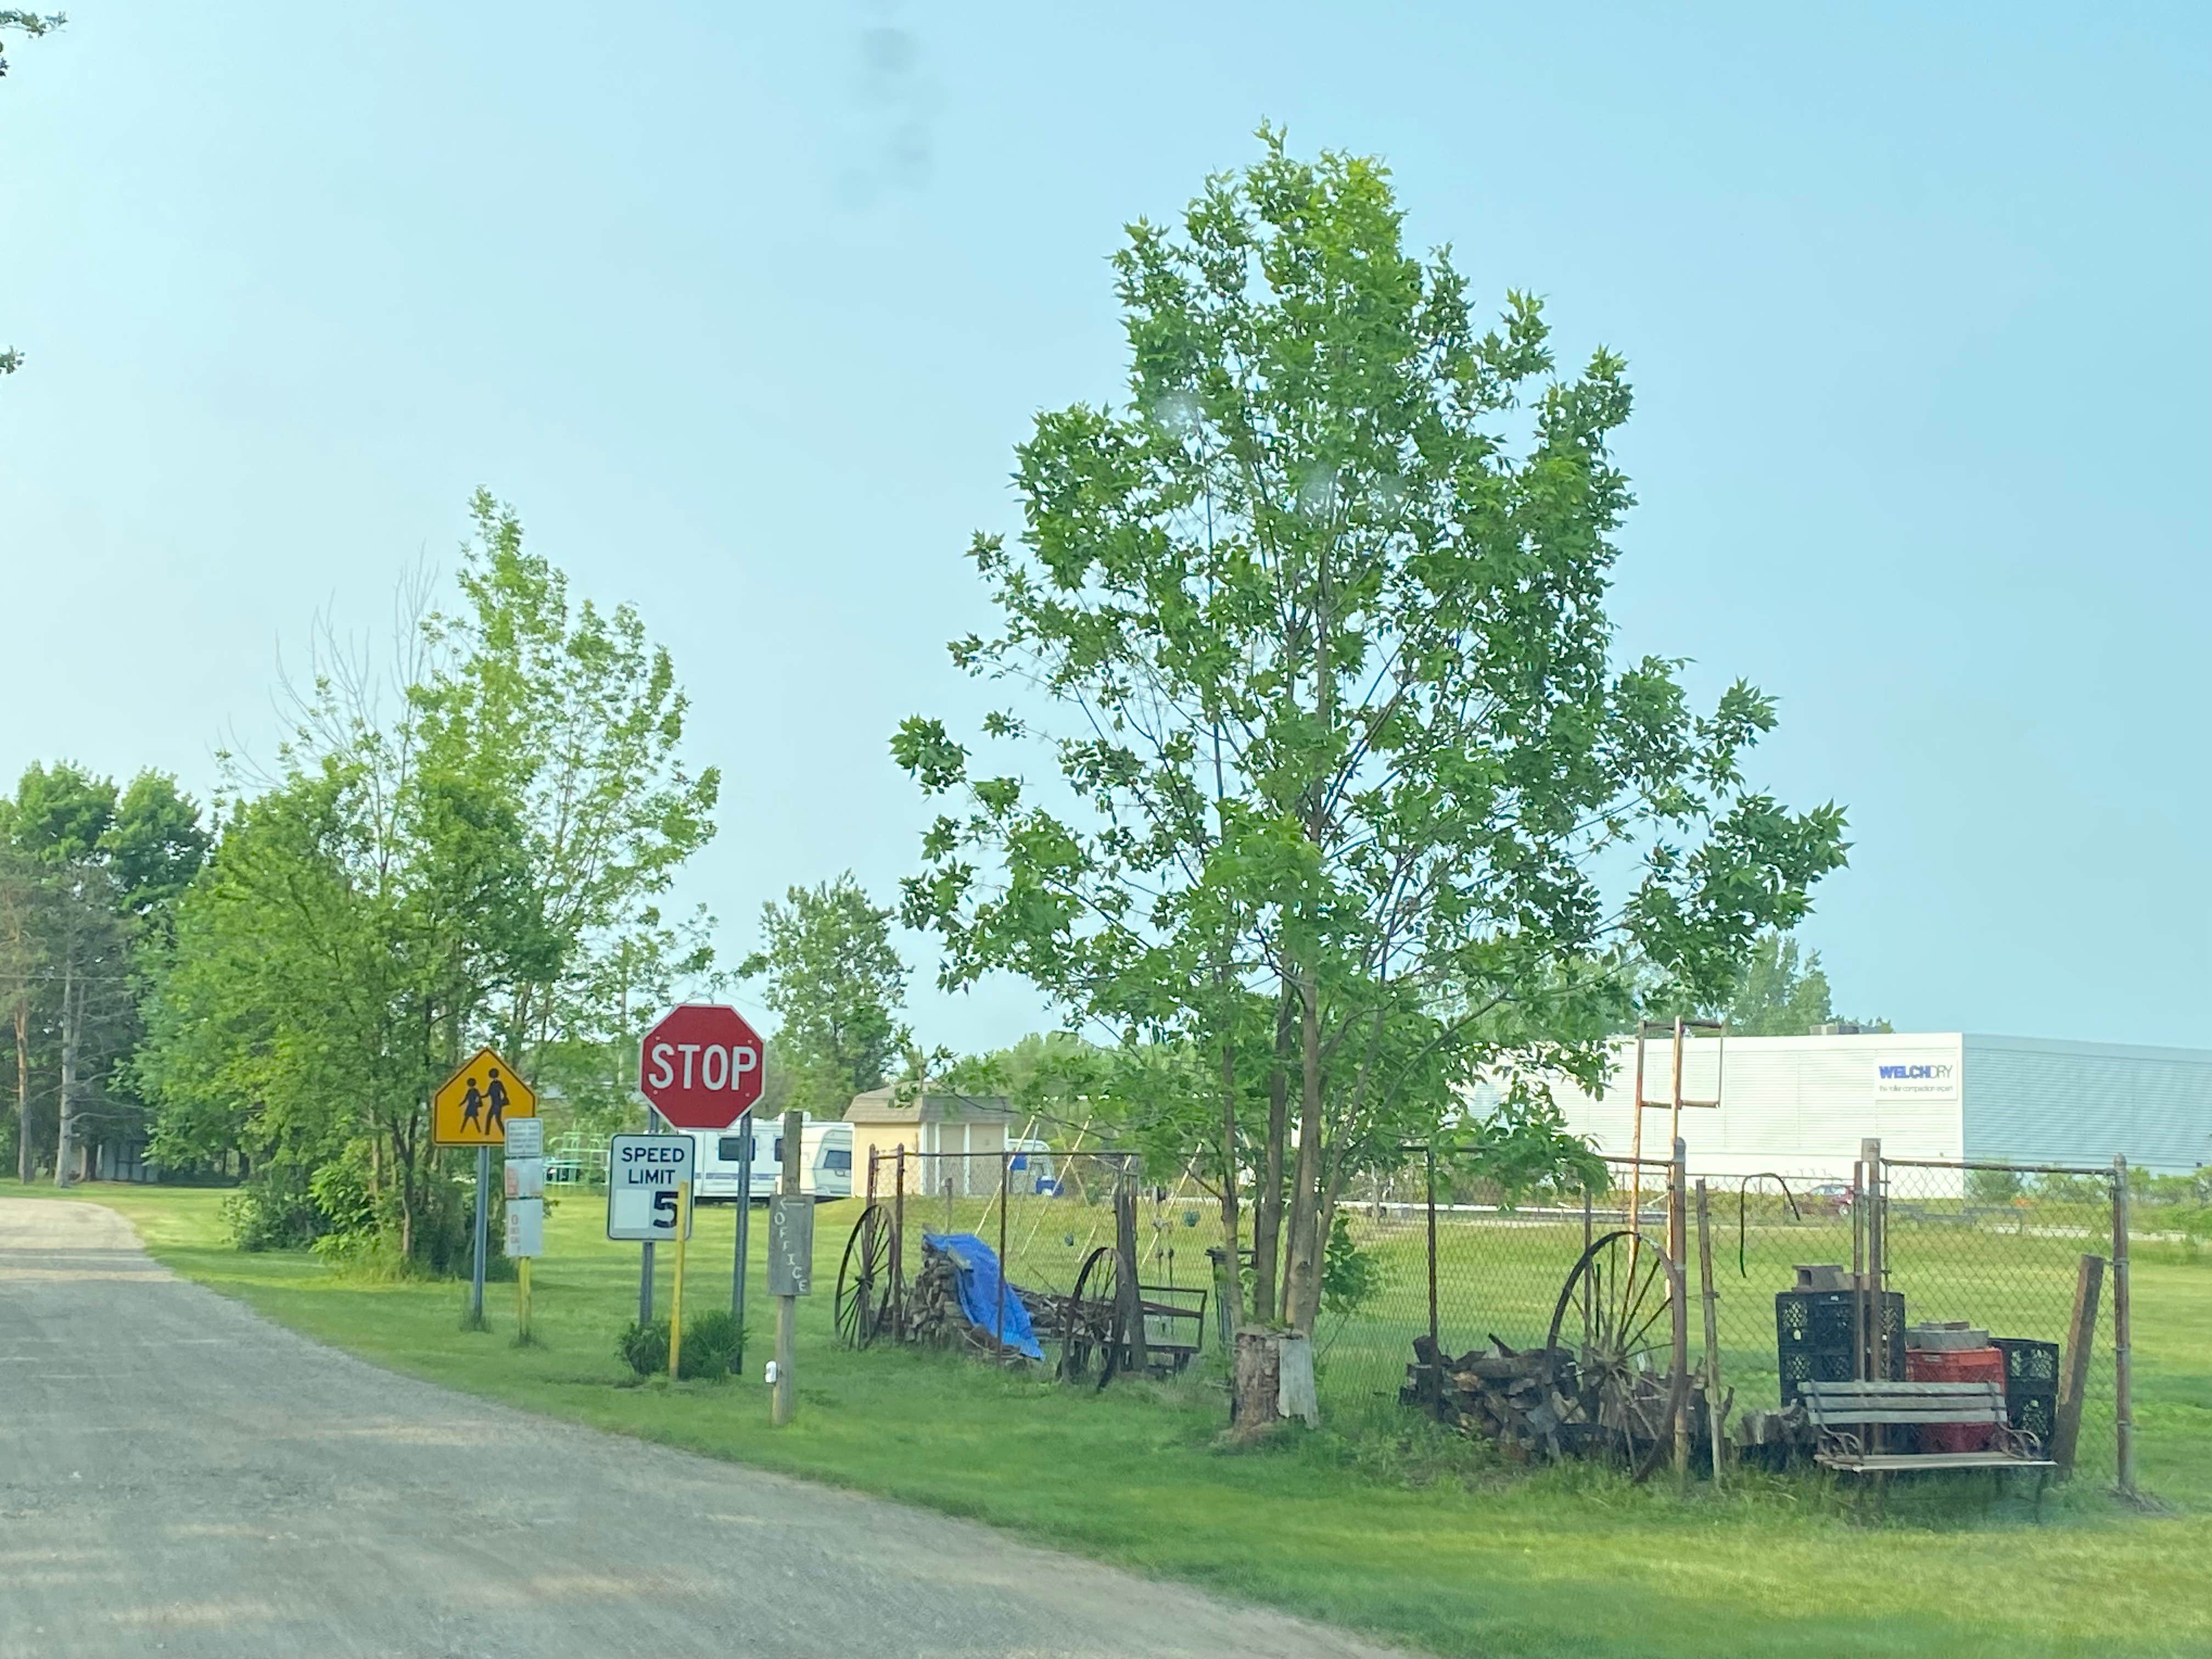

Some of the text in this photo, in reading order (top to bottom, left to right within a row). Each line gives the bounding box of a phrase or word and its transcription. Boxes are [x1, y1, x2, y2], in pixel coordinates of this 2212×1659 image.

[648, 1043, 757, 1091] STOP
[1878, 1065, 1953, 1079] WELCHDRY
[621, 1147, 685, 1163] SPEED
[628, 1169, 676, 1184] LIMIT
[653, 1191, 679, 1228] 5
[774, 1212, 808, 1292] OFFICE
